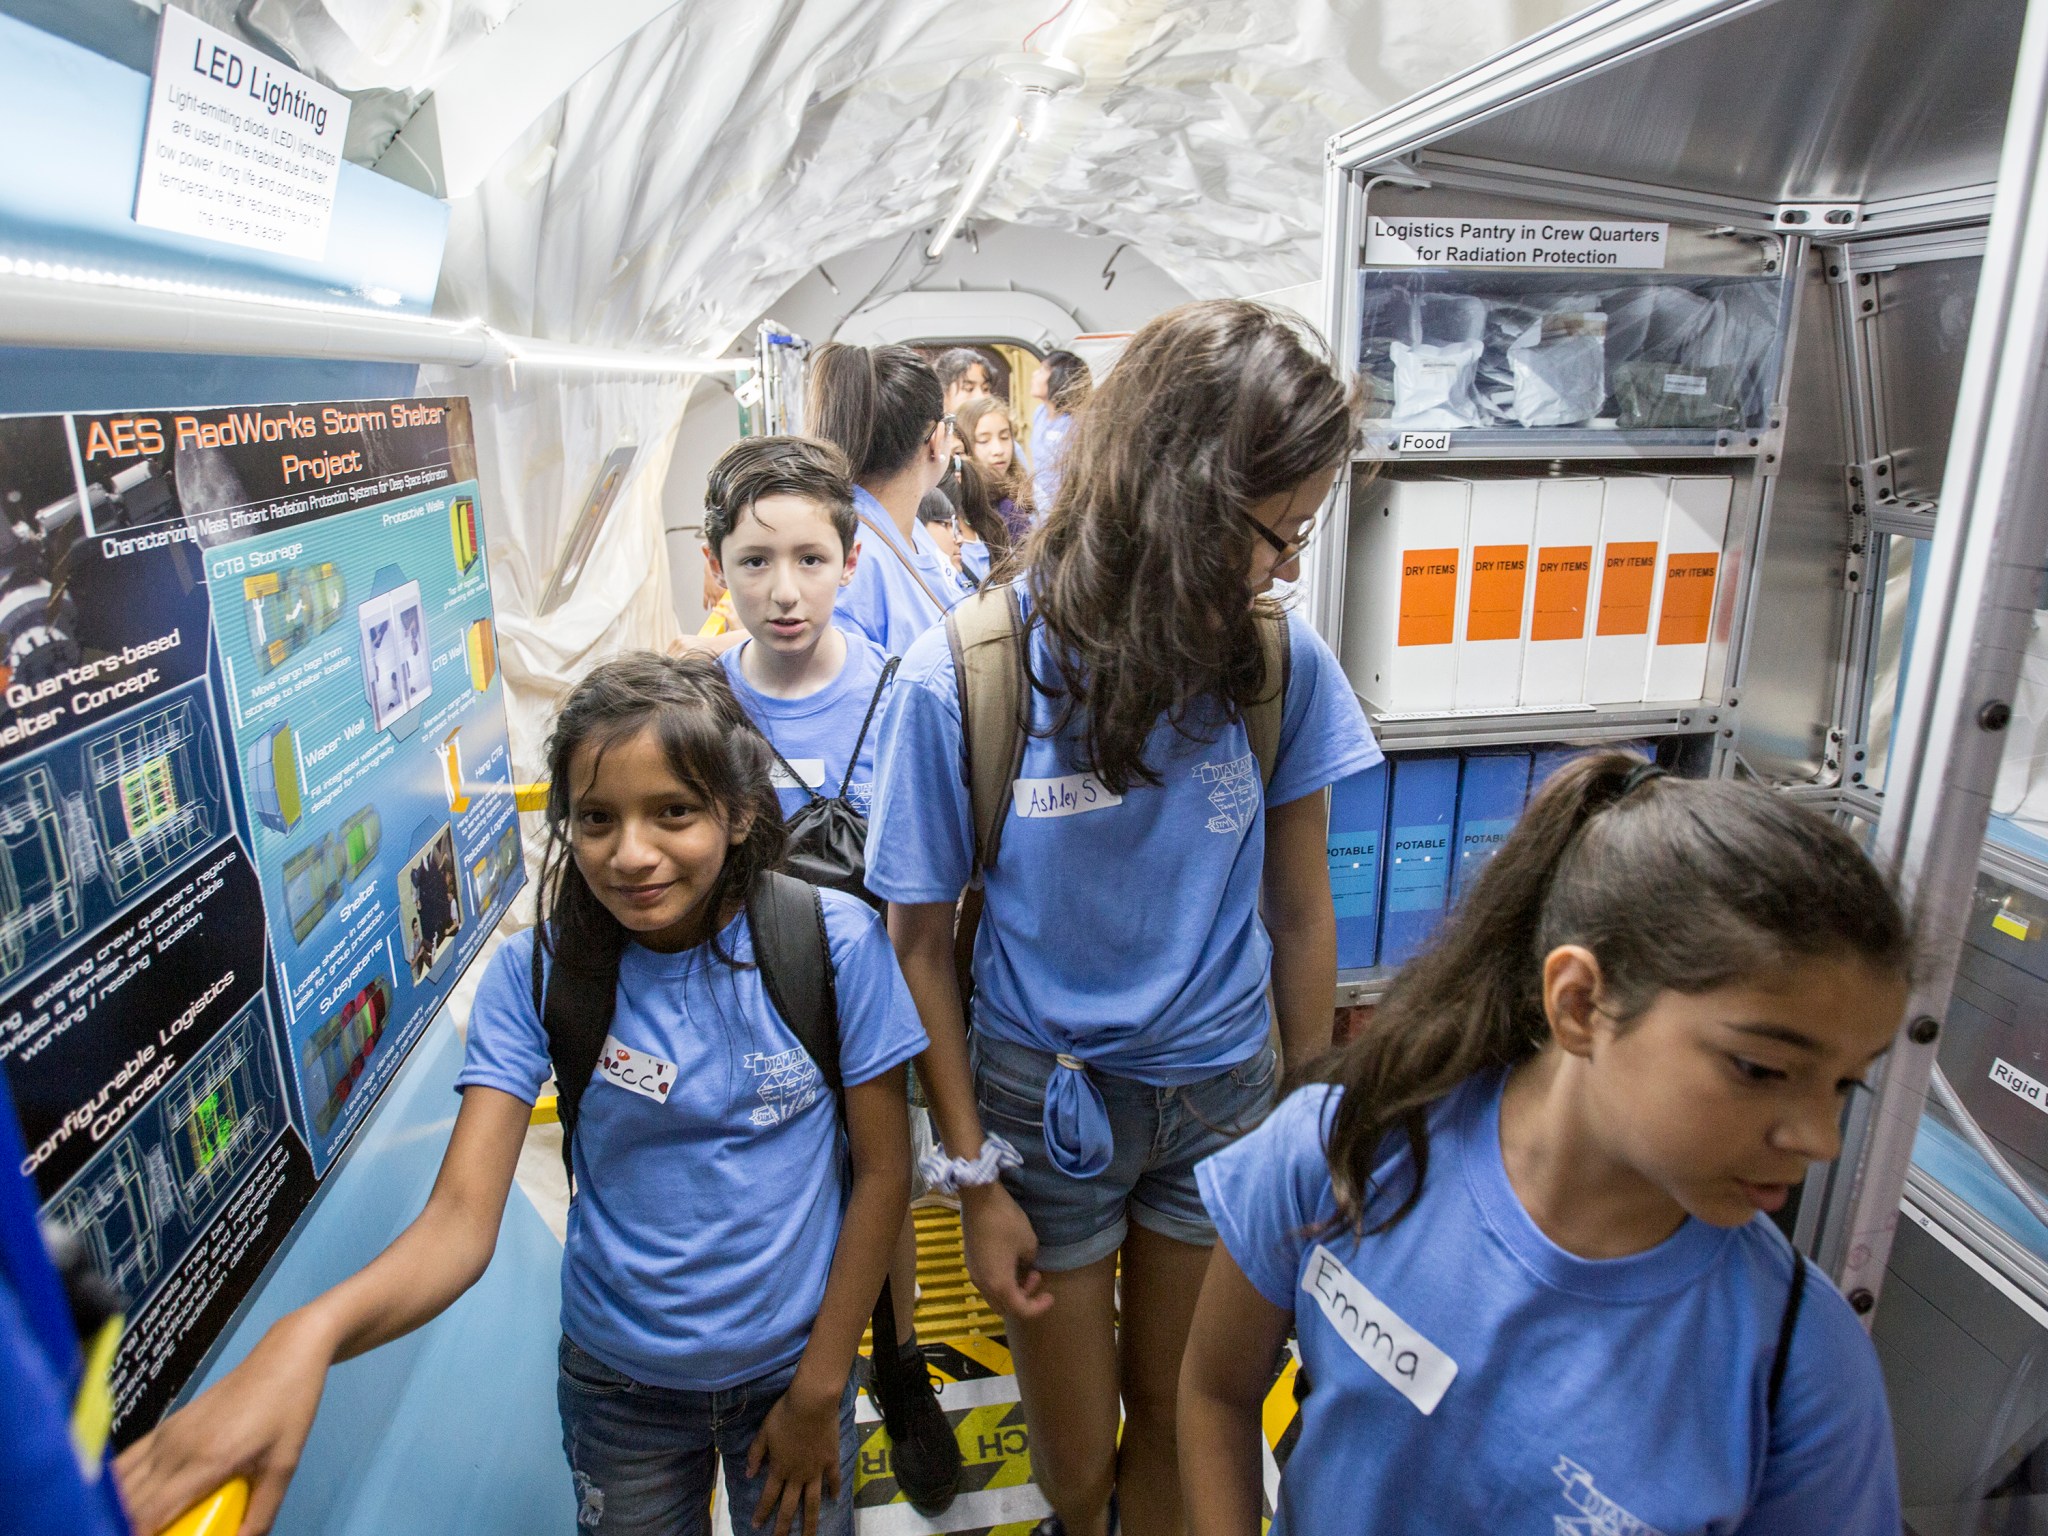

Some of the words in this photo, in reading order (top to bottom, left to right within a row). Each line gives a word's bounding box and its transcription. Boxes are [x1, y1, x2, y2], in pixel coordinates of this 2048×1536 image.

[193, 38, 243, 90] LED
[249, 66, 328, 136] Lighting
[168, 84, 241, 132] Light-emitting
[243, 115, 269, 140] diode
[271, 126, 297, 150] (LED)
[172, 119, 191, 138] are
[194, 127, 220, 148] used
[223, 134, 233, 151] in
[234, 138, 250, 159] the
[252, 145, 283, 169] habitat
[156, 138, 176, 161] low
[218, 159, 240, 185] long
[158, 170, 225, 204] temperature
[1374, 222, 1455, 240] Logistics
[1460, 224, 1516, 243] Pantry
[1520, 225, 1536, 240] in
[1541, 226, 1585, 241] Crew
[1588, 227, 1660, 243] Quarters
[1416, 246, 1441, 261] for
[1446, 247, 1527, 263] Radiation
[1532, 248, 1618, 264] Protection
[86, 418, 165, 461] AES
[174, 411, 317, 451] RadWorks
[322, 408, 387, 436] Storm
[390, 403, 445, 429] Shelter
[1402, 435, 1447, 450] Food
[281, 450, 363, 485] Project
[102, 523, 198, 559] Characterizing
[198, 515, 229, 536] Mass
[230, 508, 269, 529] Efficient
[270, 498, 309, 520] Radiation
[309, 490, 349, 511] Protection
[350, 483, 378, 503] Systems
[378, 481, 389, 495] for
[390, 479, 404, 494] Deep
[404, 473, 421, 491] Space
[421, 468, 448, 488] Exploration
[382, 504, 425, 528] Protective
[425, 500, 445, 515] Walls
[213, 556, 245, 580] CTB
[249, 543, 303, 568] Storage
[1405, 565, 1424, 577] DRY
[1427, 564, 1456, 575] ITEMS
[1475, 561, 1494, 572] DRY
[1497, 560, 1525, 571] ITEMS
[1540, 562, 1558, 573] DRY
[1560, 561, 1589, 572] ITEMS
[1606, 557, 1624, 568] DRY
[1627, 556, 1654, 568] ITEMS
[1668, 568, 1687, 578] DRY
[1689, 567, 1715, 578] ITEMS
[6, 628, 182, 709] Quarters-based
[251, 681, 276, 699] Move
[278, 668, 302, 686] cargo
[303, 656, 323, 673] bags
[324, 646, 343, 661] from
[432, 653, 448, 672] CTB
[449, 643, 463, 661] Wall
[0, 706, 65, 749] elter
[71, 668, 160, 716] Concept
[244, 694, 281, 719] storage
[282, 686, 293, 697] to
[294, 672, 322, 690] shelter
[323, 655, 352, 675] location
[304, 735, 342, 768] Water
[343, 718, 366, 742] Wall
[475, 759, 491, 779] Hang
[491, 744, 504, 764] CTB
[310, 786, 321, 799] Fill
[322, 757, 359, 790] integrated
[311, 785, 343, 814] designed
[344, 776, 355, 789] for
[355, 745, 395, 779] microgravity
[1027, 783, 1077, 818] Ashley
[1082, 778, 1097, 803] S
[464, 832, 491, 868] Relocate
[490, 804, 515, 835] Logistics
[1395, 838, 1446, 851] POTABLE
[32, 957, 95, 1009] existing
[96, 926, 135, 962] crew
[138, 882, 194, 933] quarters
[195, 850, 237, 888] regions
[340, 880, 378, 923] Shelter
[0, 1012, 51, 1060] ovides
[54, 1000, 66, 1016] a
[68, 954, 125, 1003] familiar
[128, 930, 153, 958] and
[154, 877, 225, 937] comfortable
[292, 966, 321, 998] Locate
[322, 936, 348, 967] shelter
[349, 927, 356, 938] in
[357, 900, 381, 930] central
[295, 987, 314, 1012] aisle
[315, 973, 328, 990] for
[329, 948, 350, 977] group
[351, 910, 385, 948] protection
[320, 938, 384, 1015] Subsystems
[20, 1004, 88, 1062] working
[99, 953, 151, 1001] resting
[156, 911, 204, 954] location
[20, 1044, 157, 1177] configurable
[159, 970, 235, 1047] Logistics
[326, 1095, 369, 1157] subsystems
[370, 1083, 378, 1096] to
[378, 1051, 400, 1083] reduce
[400, 1017, 425, 1054] parasitic
[344, 1072, 376, 1117] Leverage
[376, 1045, 395, 1072] dense
[395, 1004, 424, 1046] stationary
[1994, 1063, 2039, 1101] Rigid
[90, 1053, 177, 1142] Concept
[135, 1260, 209, 1361] components
[211, 1228, 231, 1260] and
[233, 1150, 290, 1230] repositioned
[142, 1276, 182, 1334] panels
[184, 1241, 209, 1276] may
[211, 1220, 226, 1241] be
[228, 1160, 270, 1219] designed
[271, 1144, 283, 1162] as
[112, 1359, 149, 1411] otect
[152, 1278, 207, 1357] additional
[209, 1221, 250, 1279] crewed
[251, 1174, 286, 1222] regions
[1315, 1254, 1419, 1382] Emma
[112, 1381, 147, 1434] from
[150, 1339, 176, 1380] SPE
[178, 1271, 228, 1341] radiation
[230, 1214, 268, 1269] damage
